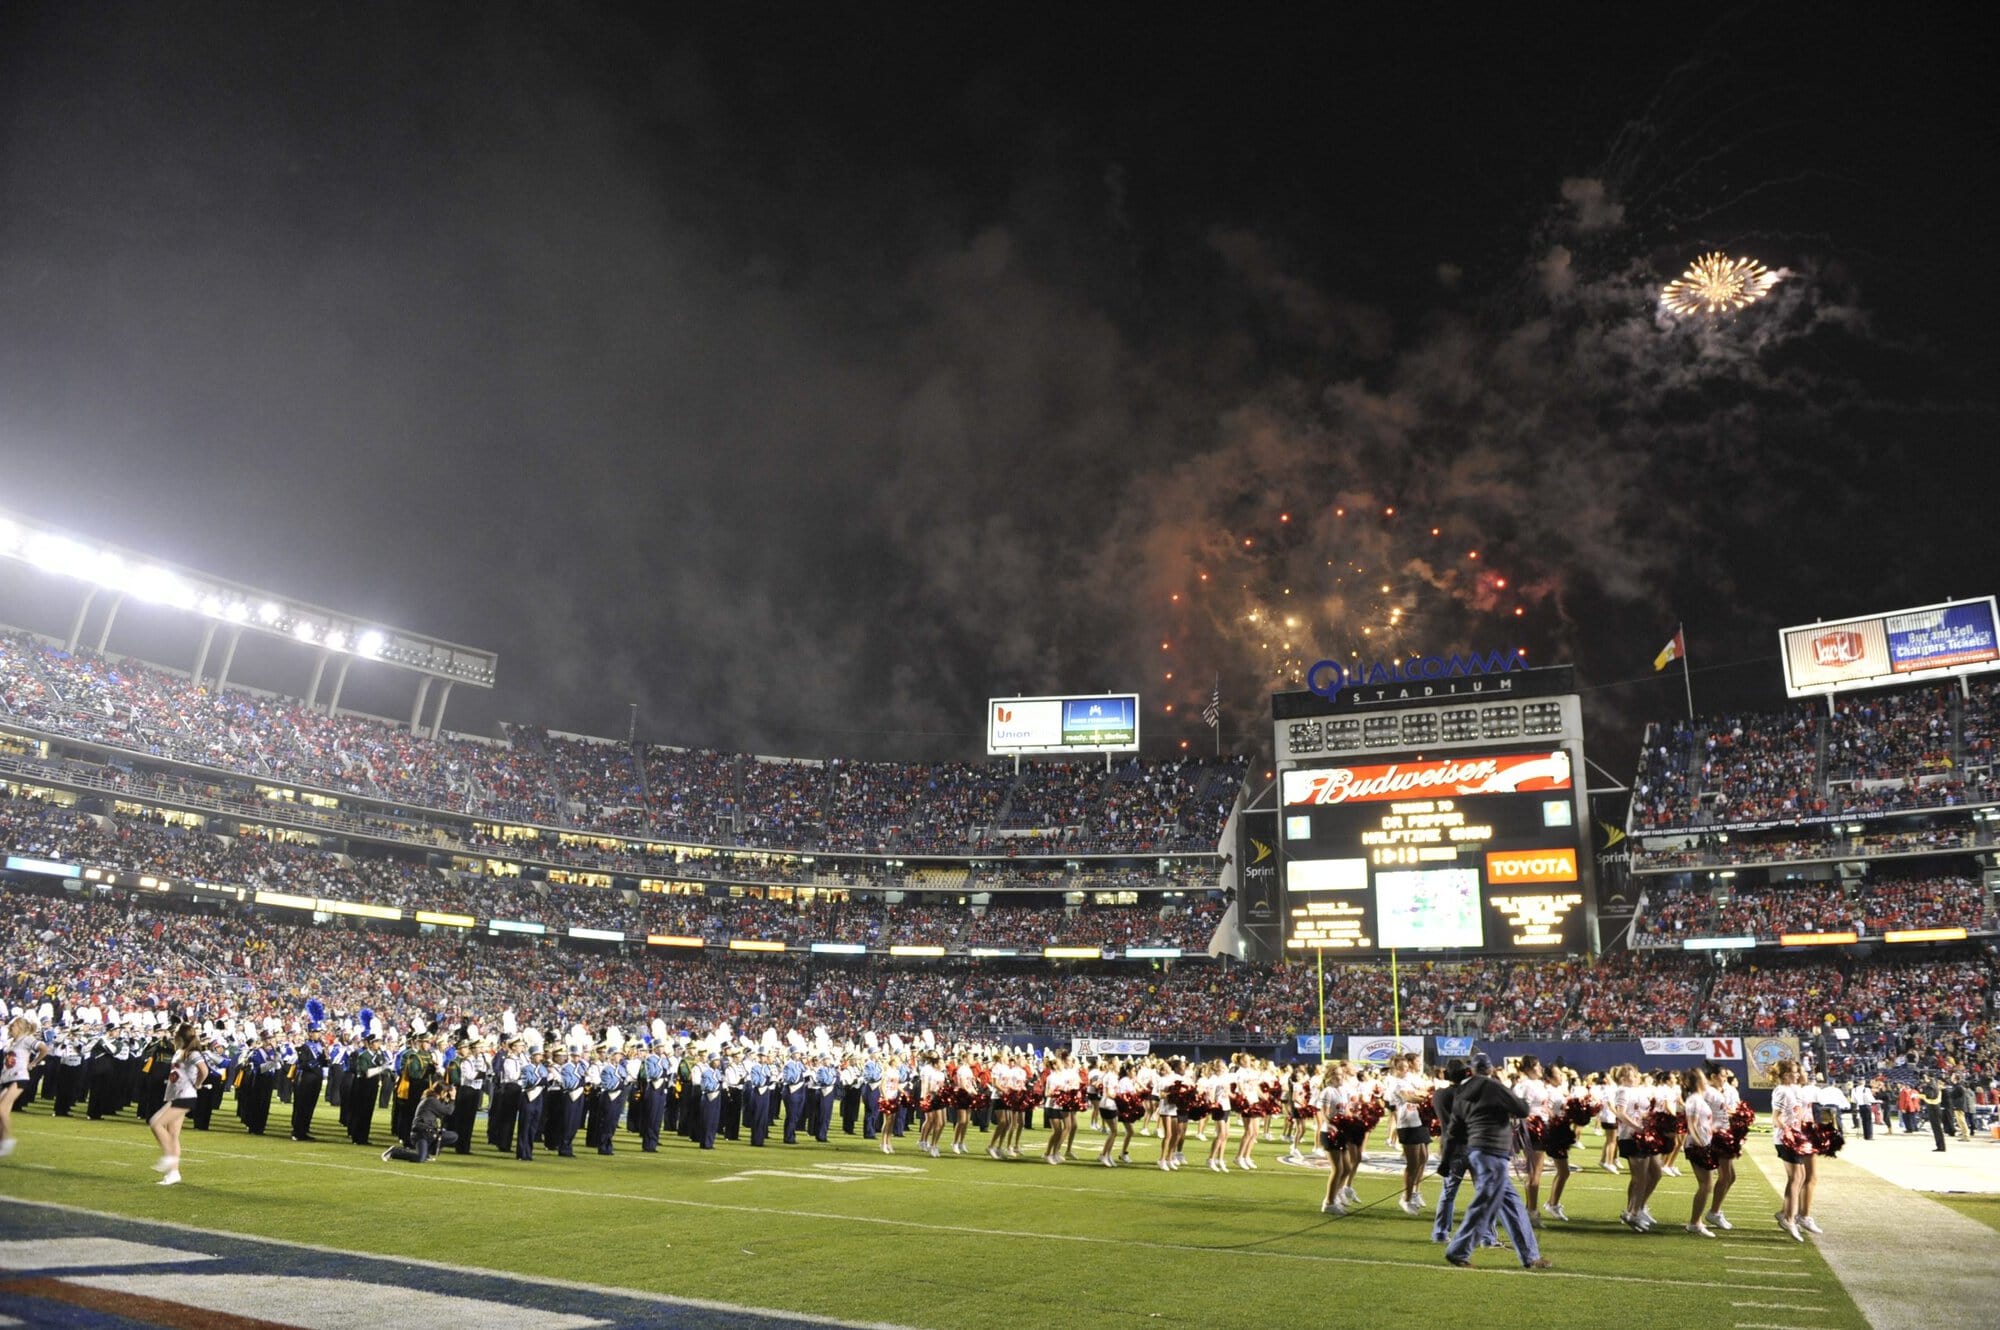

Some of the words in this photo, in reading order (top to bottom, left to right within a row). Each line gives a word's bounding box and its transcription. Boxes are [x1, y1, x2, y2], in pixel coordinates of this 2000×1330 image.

[1897, 643, 1947, 657] Chargers
[1307, 647, 1529, 703] QUALCOMM
[1353, 679, 1512, 702] STADIUM
[1305, 760, 1497, 804] Budweiser
[1596, 851, 1629, 864] Sprint
[1246, 866, 1275, 879] Sprint
[1491, 858, 1573, 877] TOYOTA
[1078, 1040, 1093, 1055] A
[1712, 1040, 1735, 1058] N
